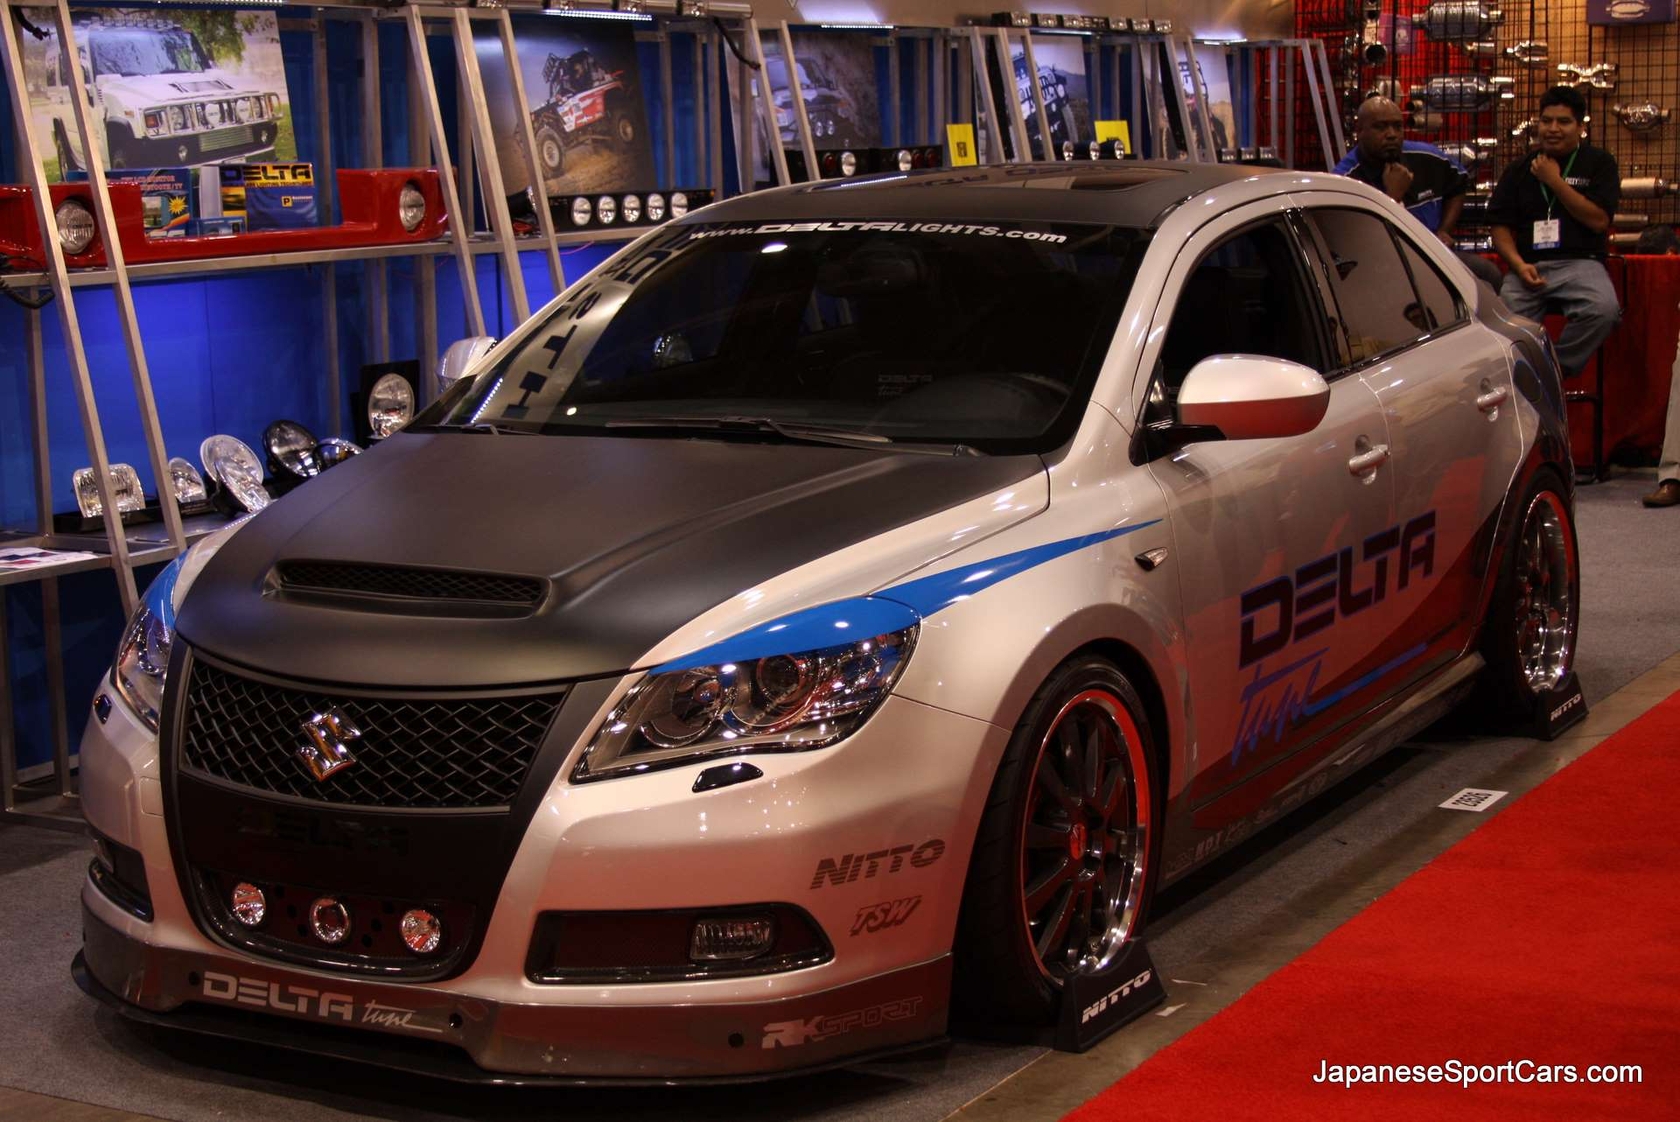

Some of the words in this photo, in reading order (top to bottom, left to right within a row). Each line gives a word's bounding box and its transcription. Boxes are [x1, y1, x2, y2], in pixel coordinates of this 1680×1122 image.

[219, 163, 313, 181] DELTA
[1237, 508, 1437, 672] DELTA
[1549, 692, 1582, 722] NITTO
[809, 838, 946, 890] NITTO
[849, 894, 923, 937] TSW
[202, 970, 354, 1021] DELTA
[1081, 968, 1152, 1025] NITTO
